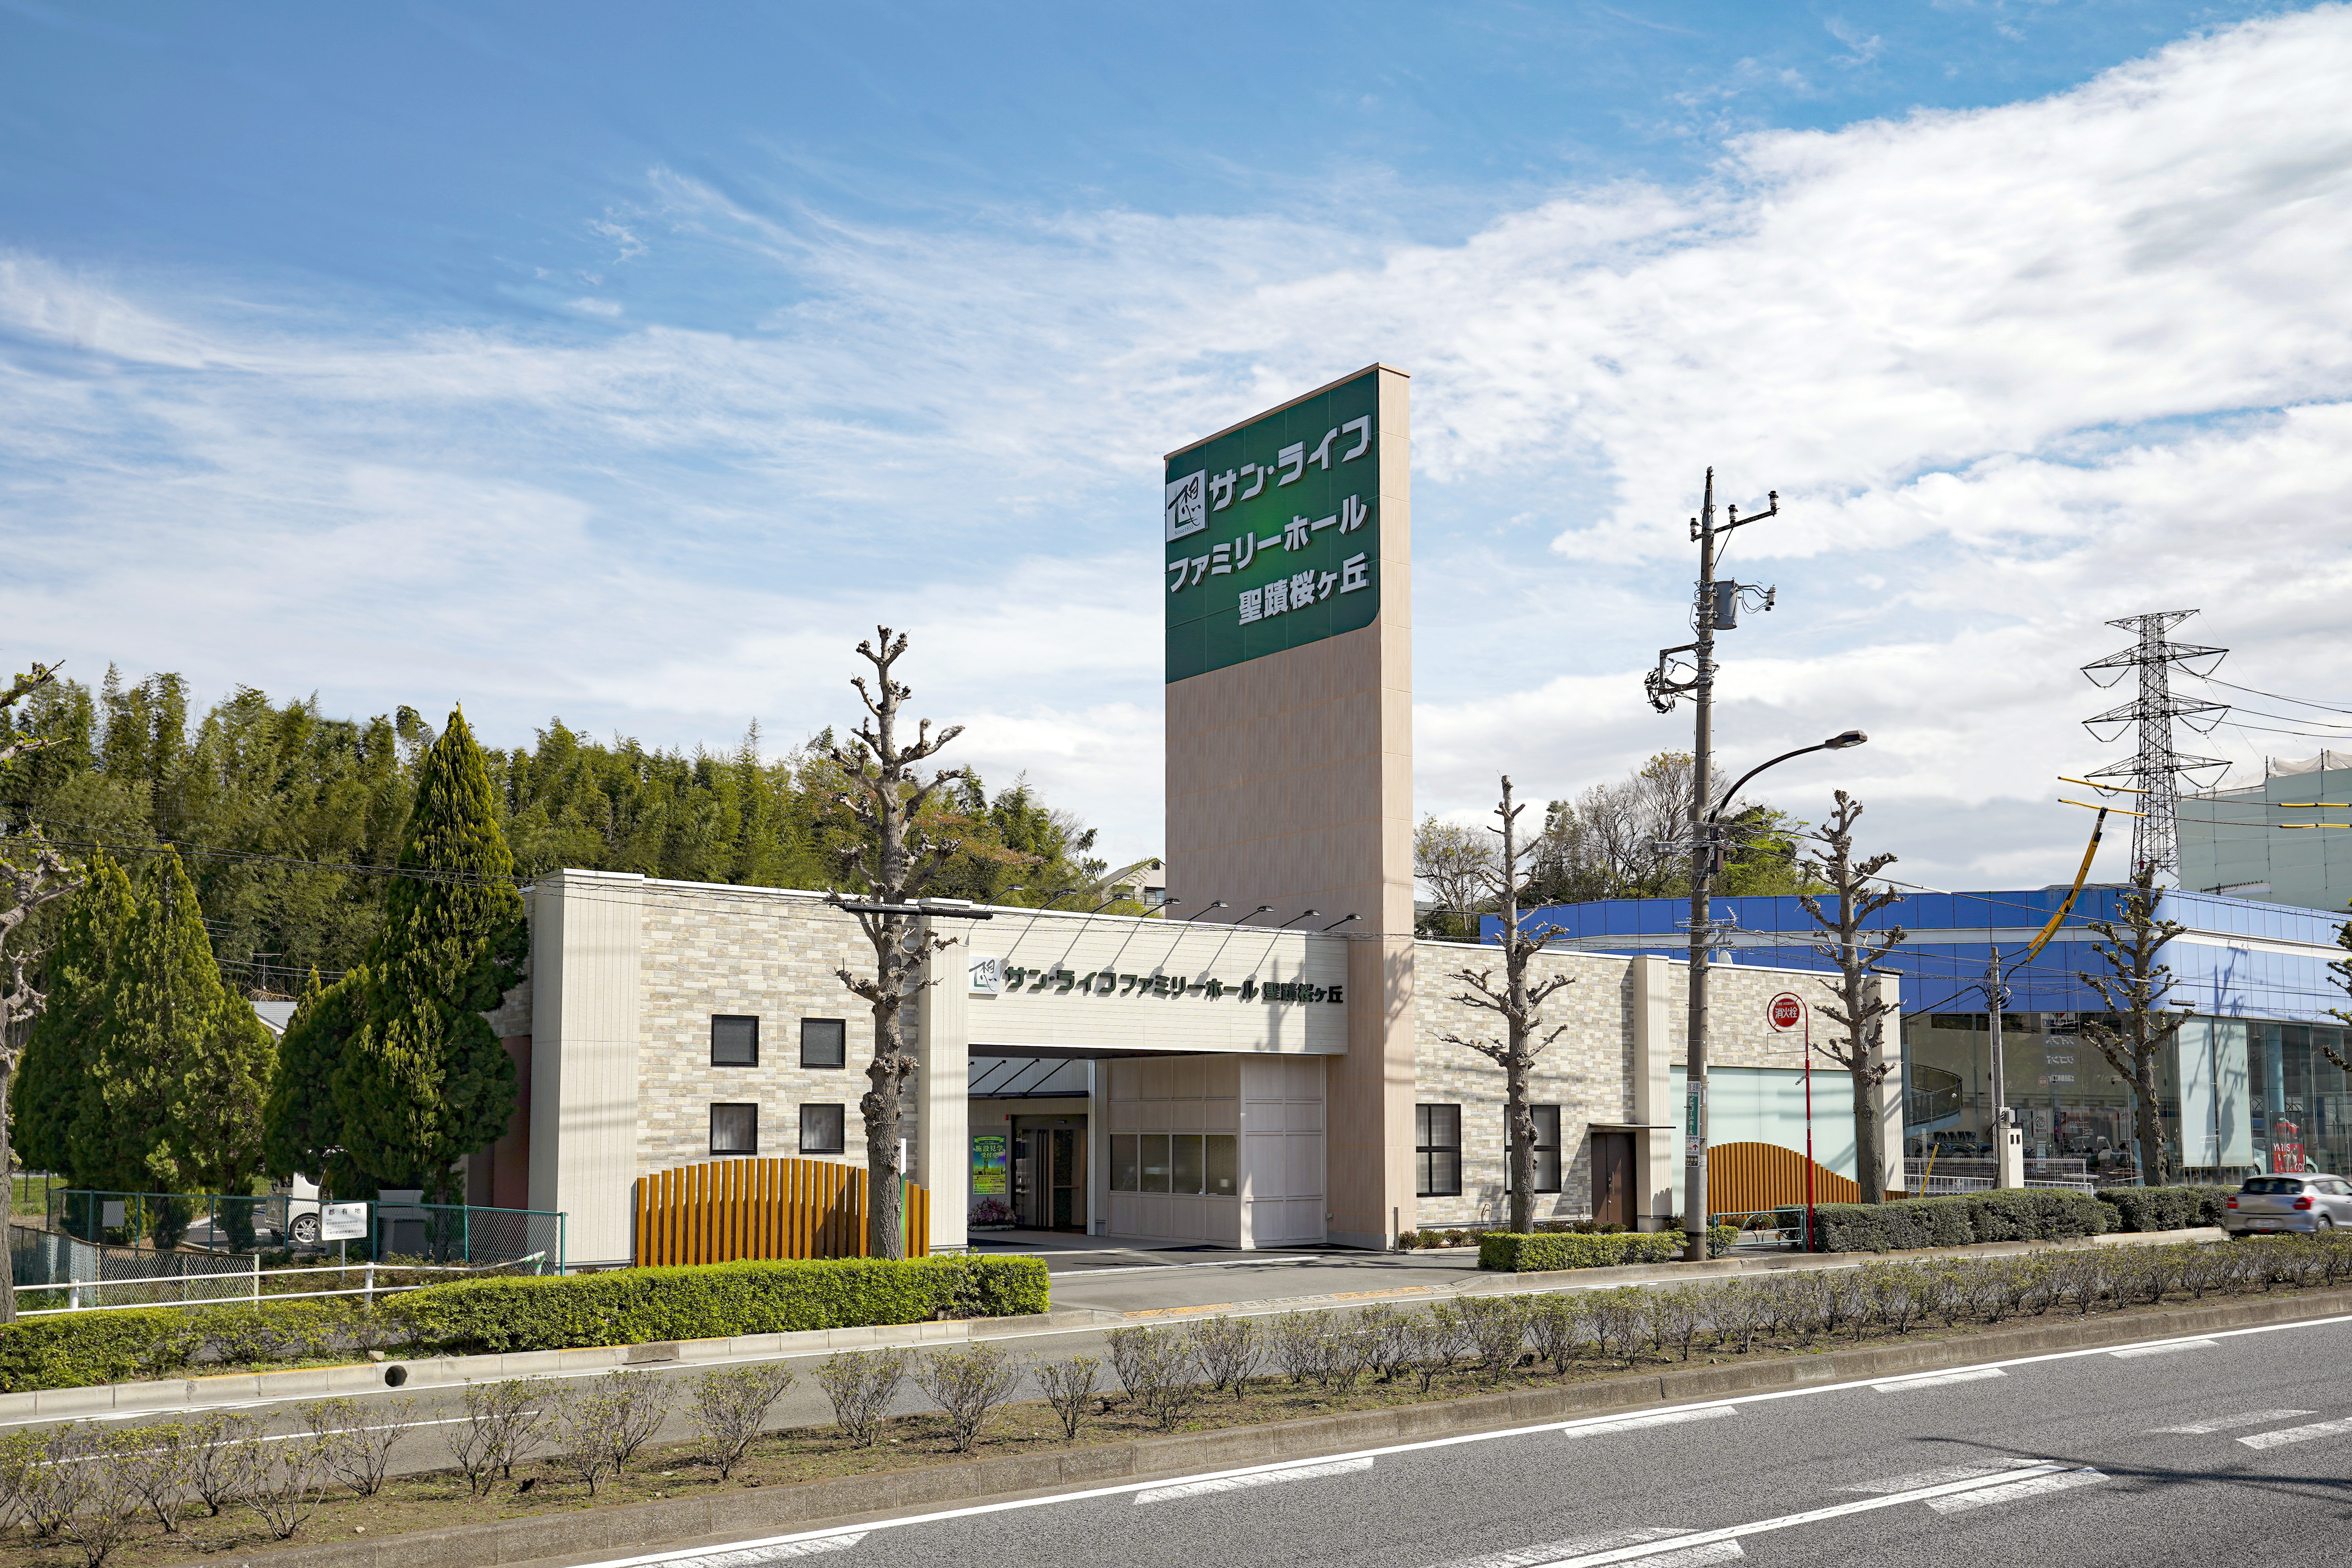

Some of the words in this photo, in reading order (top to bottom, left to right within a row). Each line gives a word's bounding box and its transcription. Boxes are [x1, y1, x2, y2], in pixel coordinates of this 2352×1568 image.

[1209, 414, 1372, 512] サン・ライフ
[1169, 494, 1371, 593] ファミリーホール
[1238, 552, 1370, 626] 聖蹟桜ヶ丘
[1775, 1007, 1798, 1019] 消火栓
[2273, 1143, 2290, 1152] YARIS
